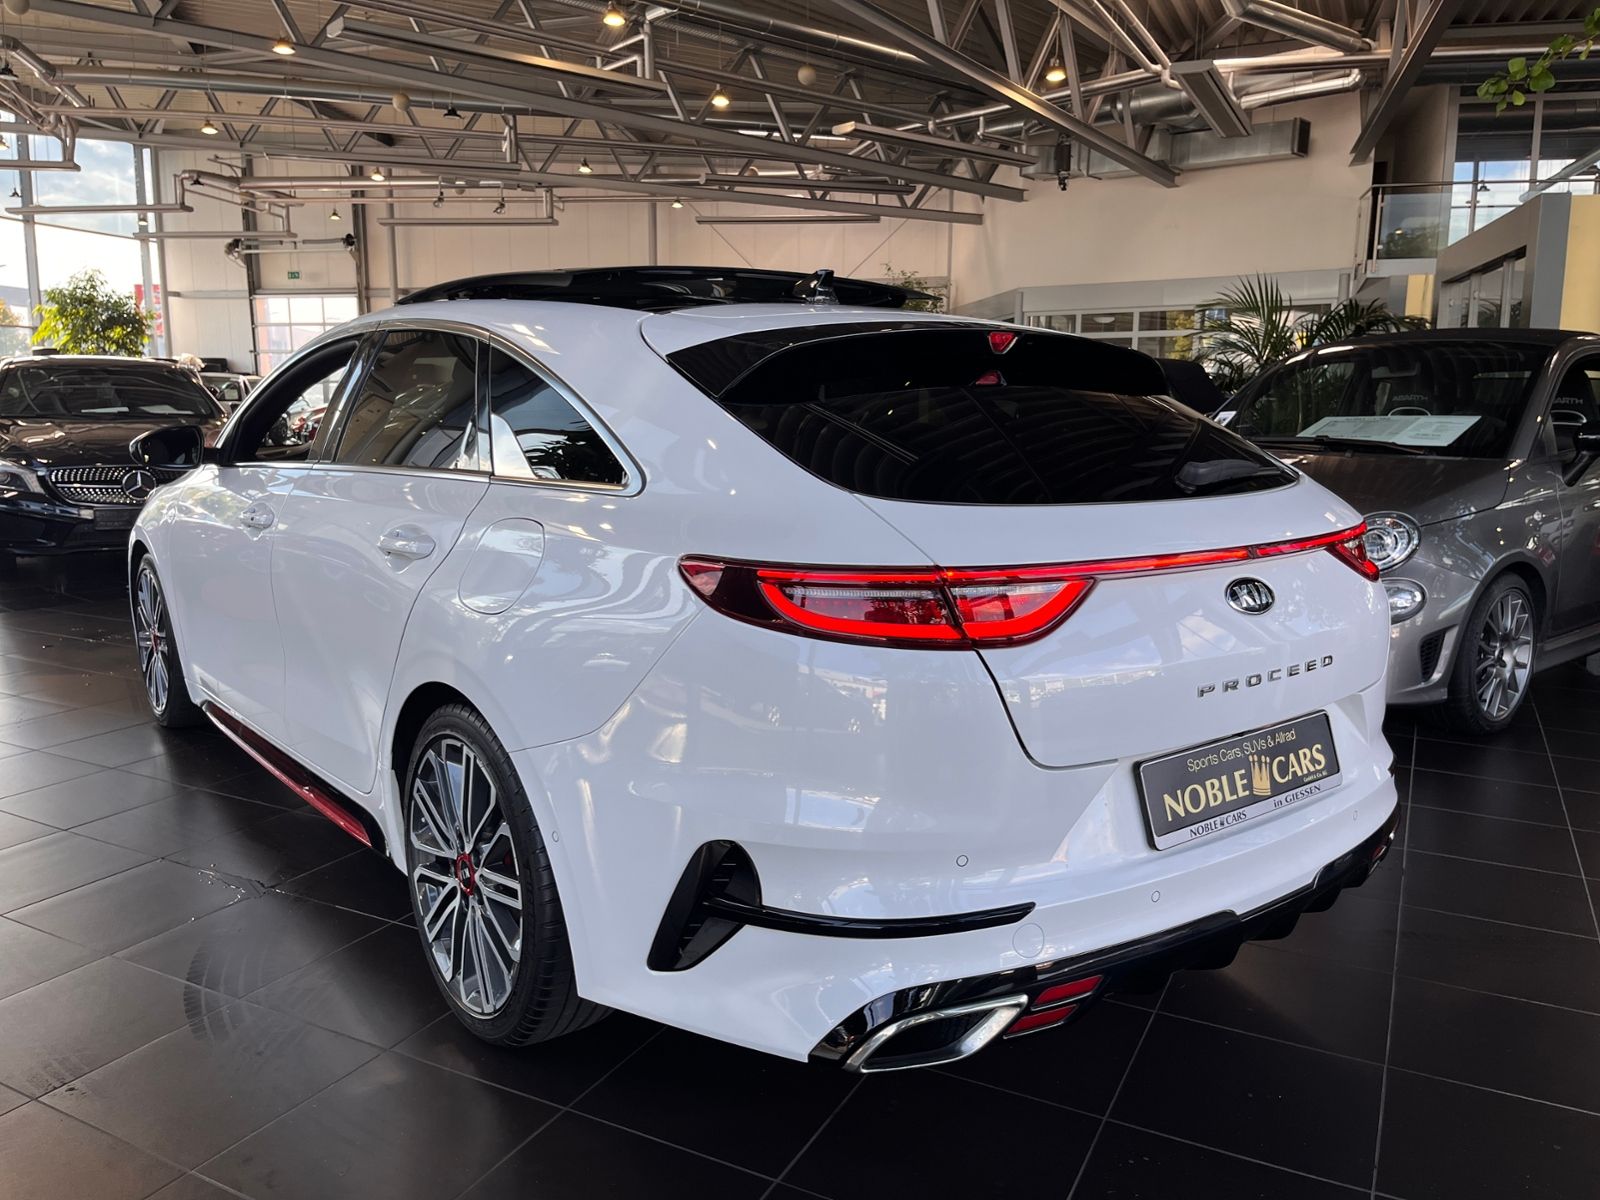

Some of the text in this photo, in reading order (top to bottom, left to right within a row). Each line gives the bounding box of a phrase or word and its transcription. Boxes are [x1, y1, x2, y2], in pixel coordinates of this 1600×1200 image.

[1392, 394, 1429, 402] ABARTH
[1232, 582, 1273, 608] KIA
[1197, 655, 1333, 698] PROCEED
[1187, 728, 1297, 773] Sports Cars, SUVs & Allrad
[1163, 744, 1326, 821] NOBLE CARS
[1189, 784, 1321, 838] NOBLE CARS in GIESSEN
